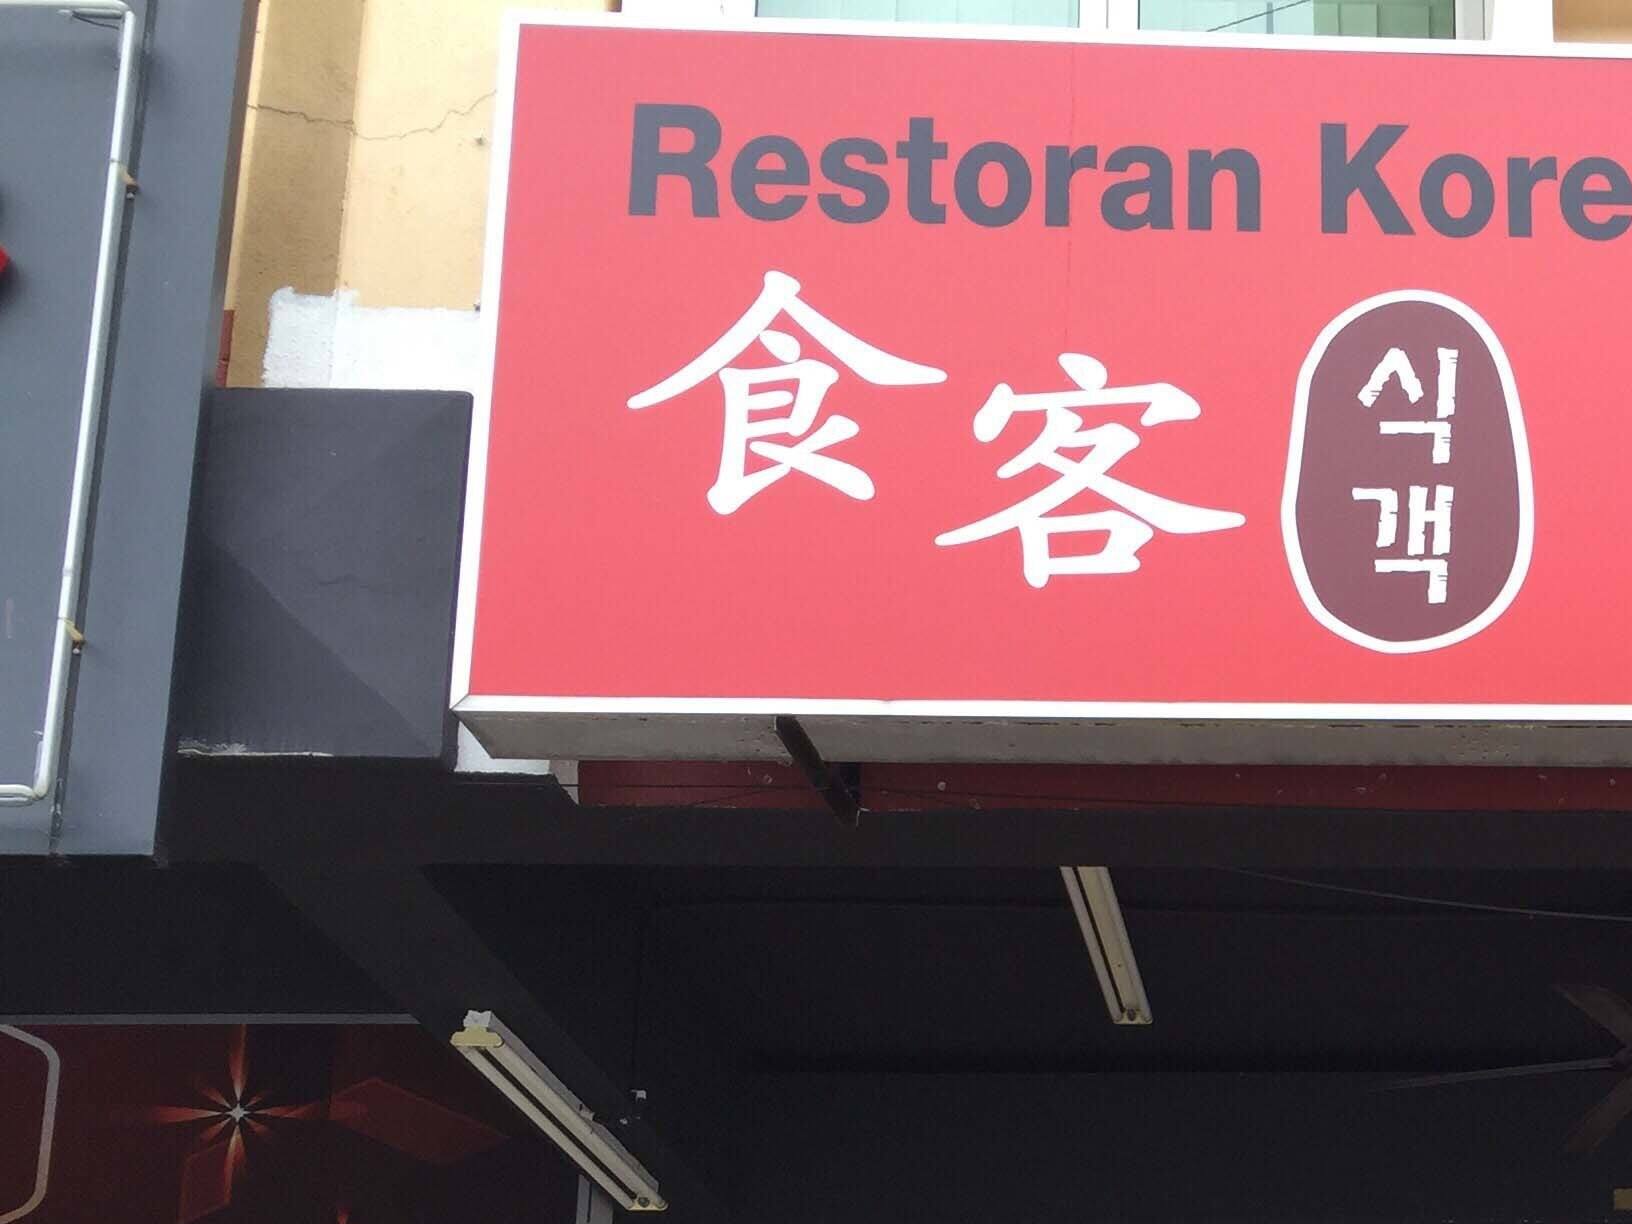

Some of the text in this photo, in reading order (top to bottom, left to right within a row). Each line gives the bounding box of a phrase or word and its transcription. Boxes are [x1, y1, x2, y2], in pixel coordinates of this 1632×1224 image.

[626, 102, 1264, 233] Restoran
[627, 270, 1246, 589] 食客
[1351, 346, 1459, 606] 식객
